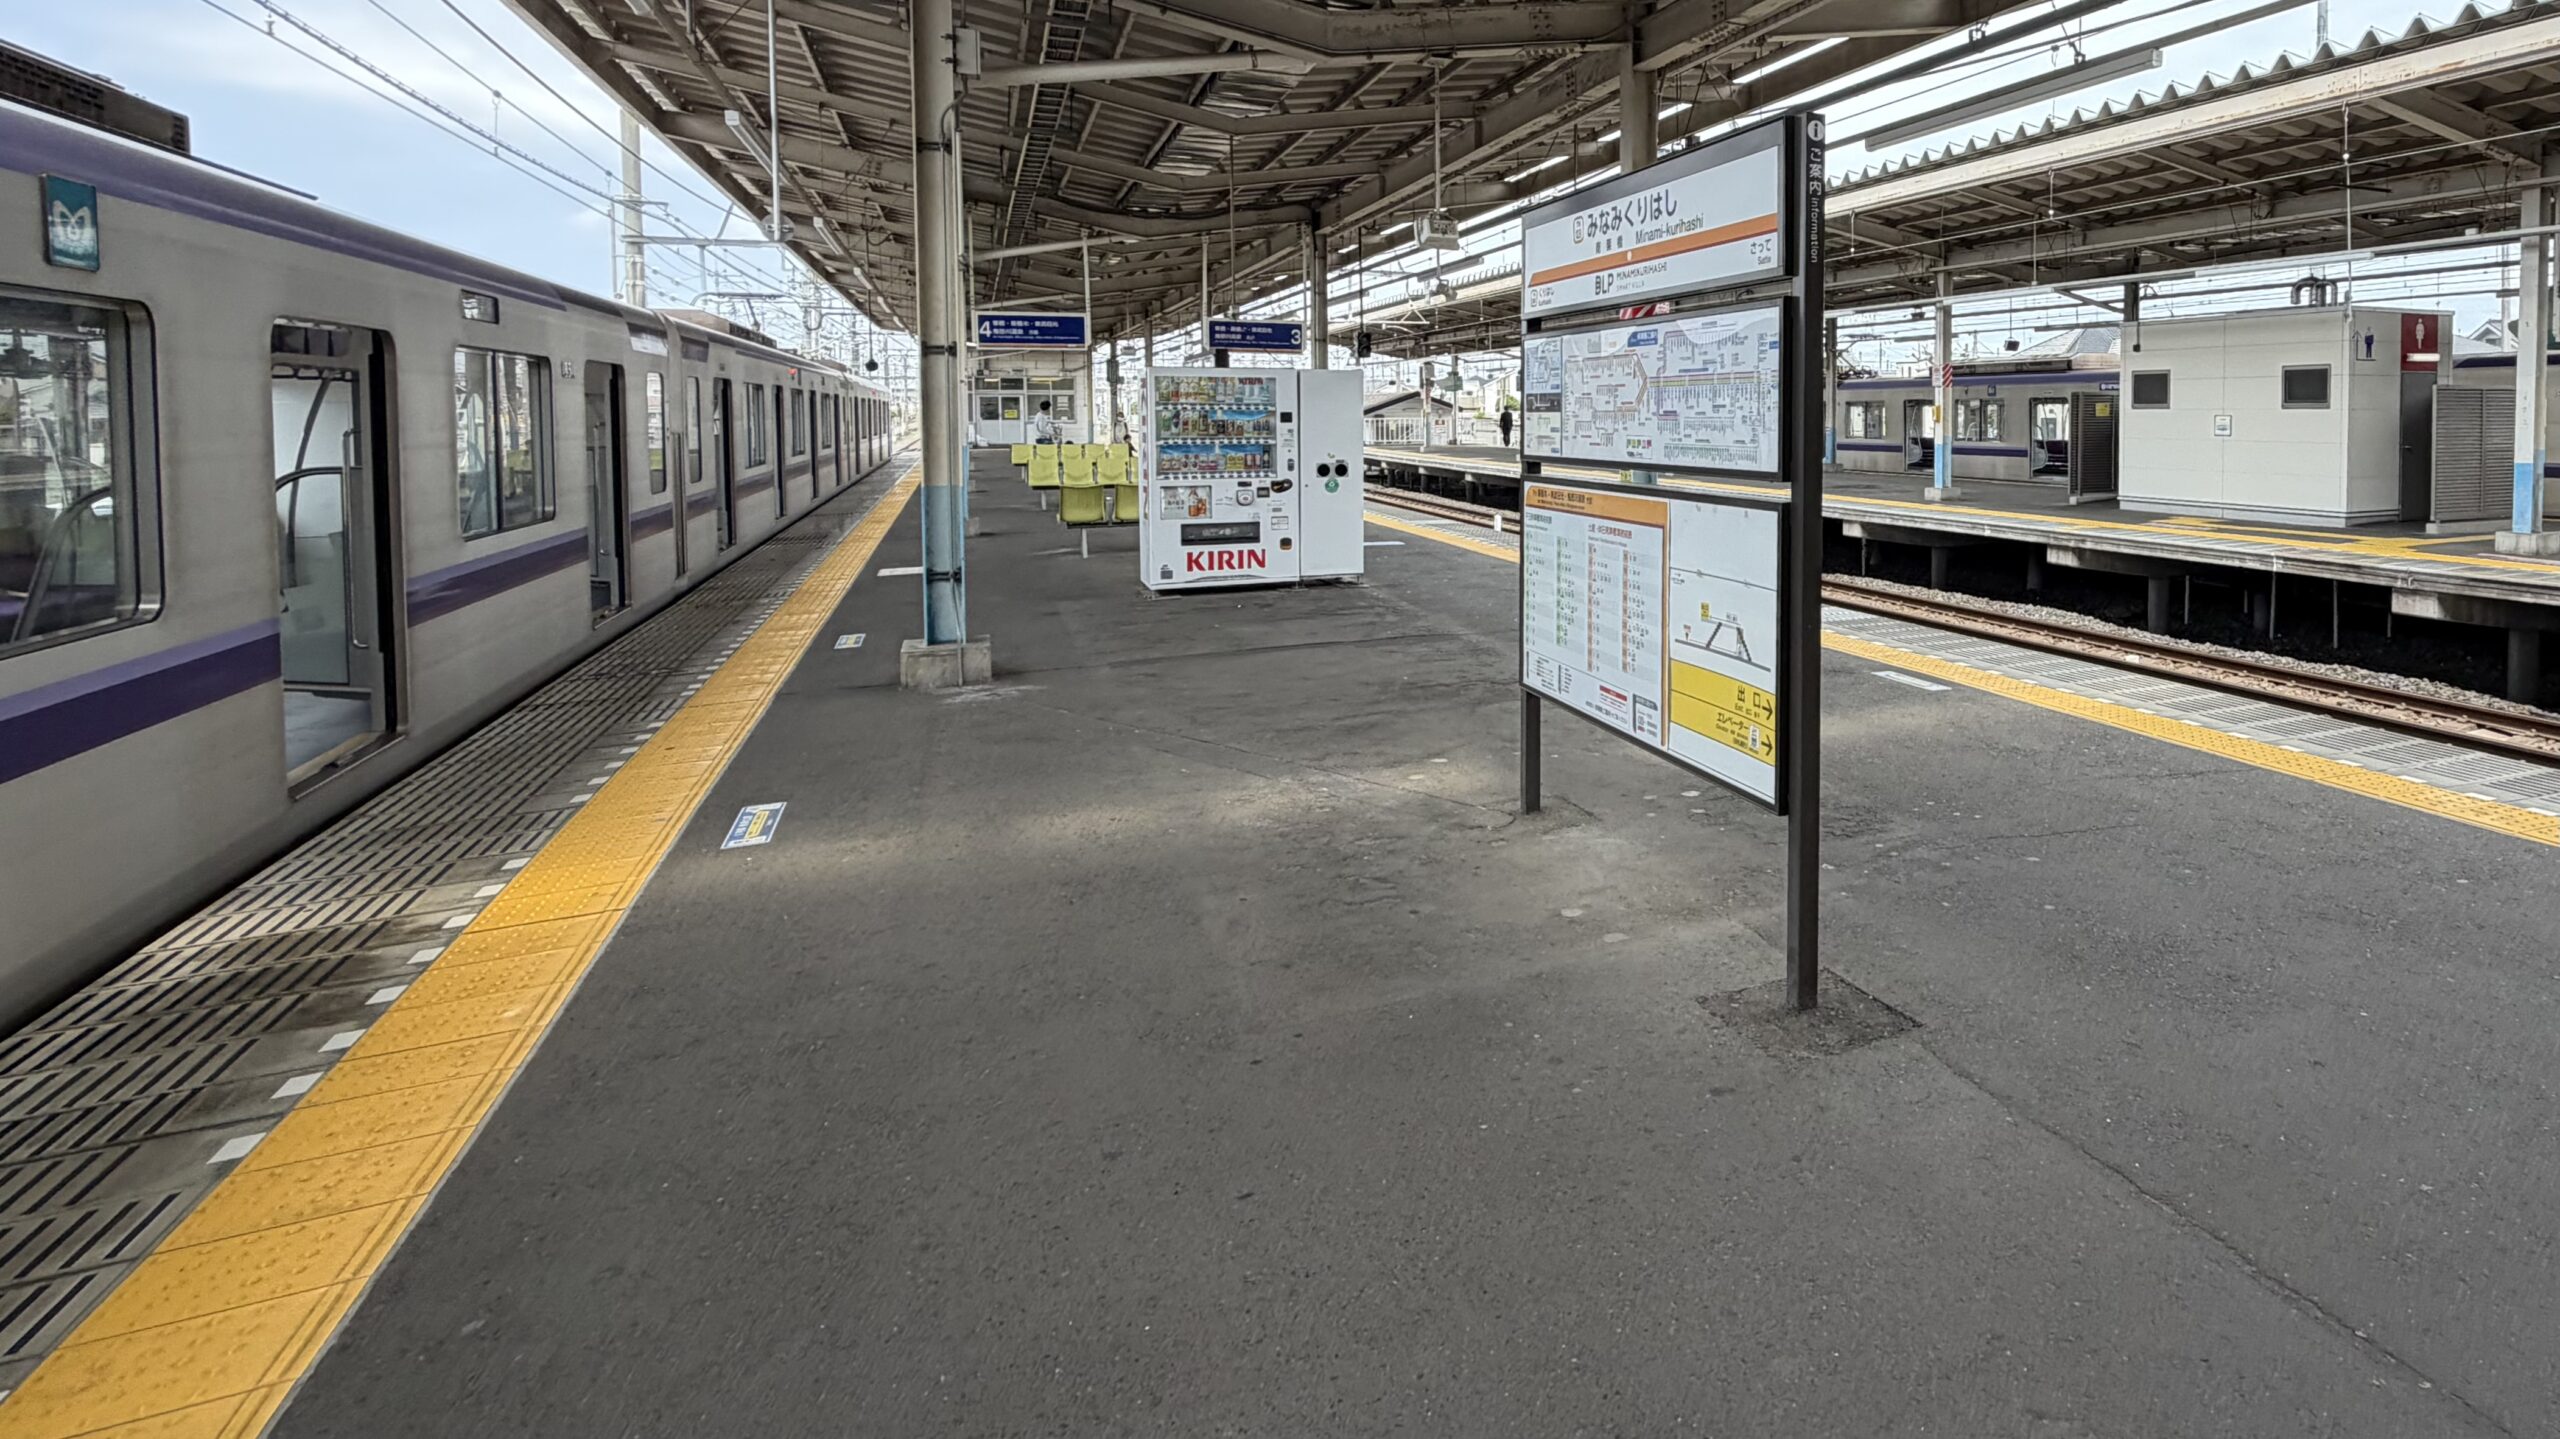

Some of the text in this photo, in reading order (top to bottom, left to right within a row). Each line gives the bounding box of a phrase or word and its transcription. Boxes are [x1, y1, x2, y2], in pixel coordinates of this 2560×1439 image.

[1809, 147, 1822, 196] ご案内
[1587, 188, 1678, 238] みなみくりはし
[1635, 213, 1704, 245] Minami-kurihashi
[1750, 238, 1771, 255] さって
[1595, 273, 1614, 296] BLP
[980, 320, 992, 338] 4
[1291, 329, 1302, 345] 3
[1187, 549, 1266, 572] KIRIN
